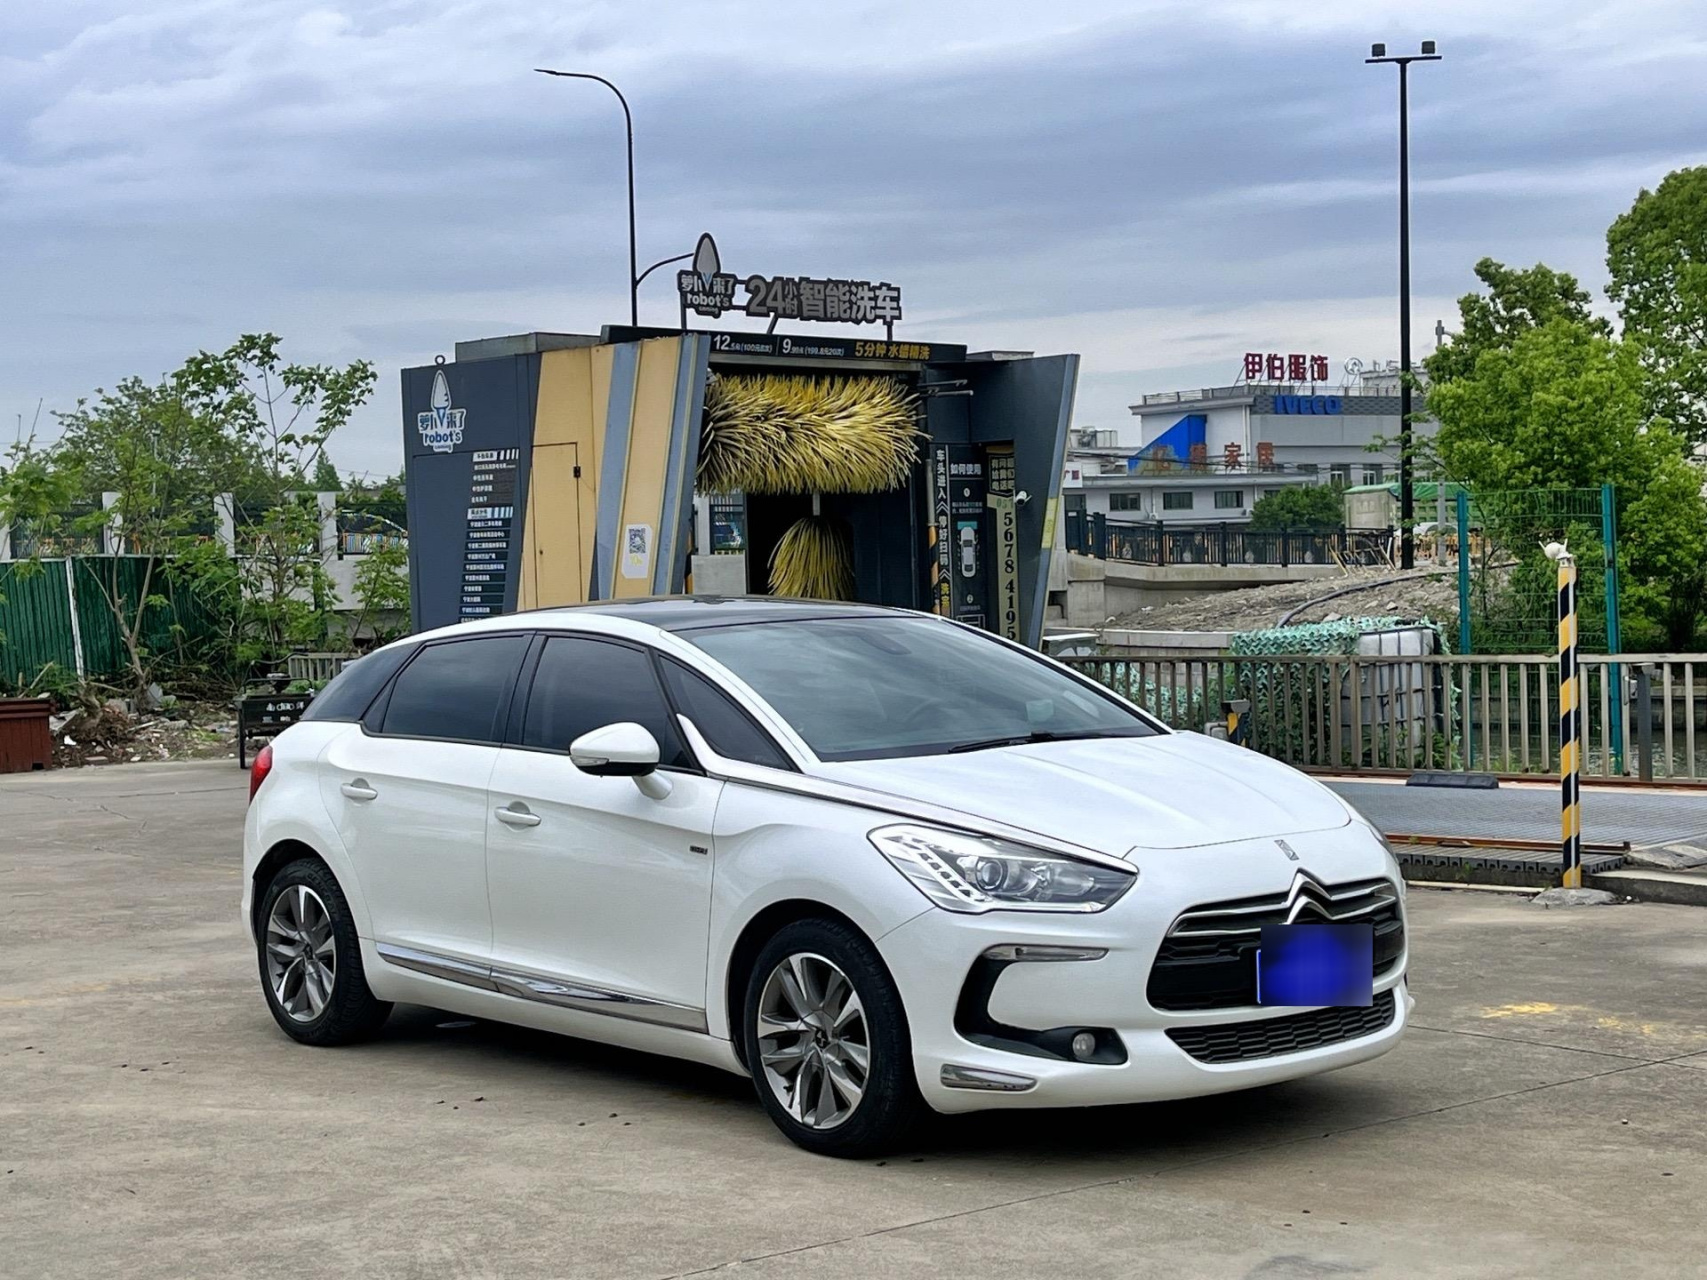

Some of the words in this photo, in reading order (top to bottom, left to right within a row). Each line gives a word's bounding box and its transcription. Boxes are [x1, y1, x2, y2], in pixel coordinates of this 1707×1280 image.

[687, 294, 730, 308] robot's
[748, 278, 901, 322] 24小时智能洗车
[1244, 353, 1329, 382] 伊伯服饰
[1274, 395, 1342, 415] IVECO
[424, 430, 461, 443] robot's
[936, 449, 947, 499] 车头进入
[950, 463, 982, 476] 如何使用
[1003, 512, 1015, 574] 5678
